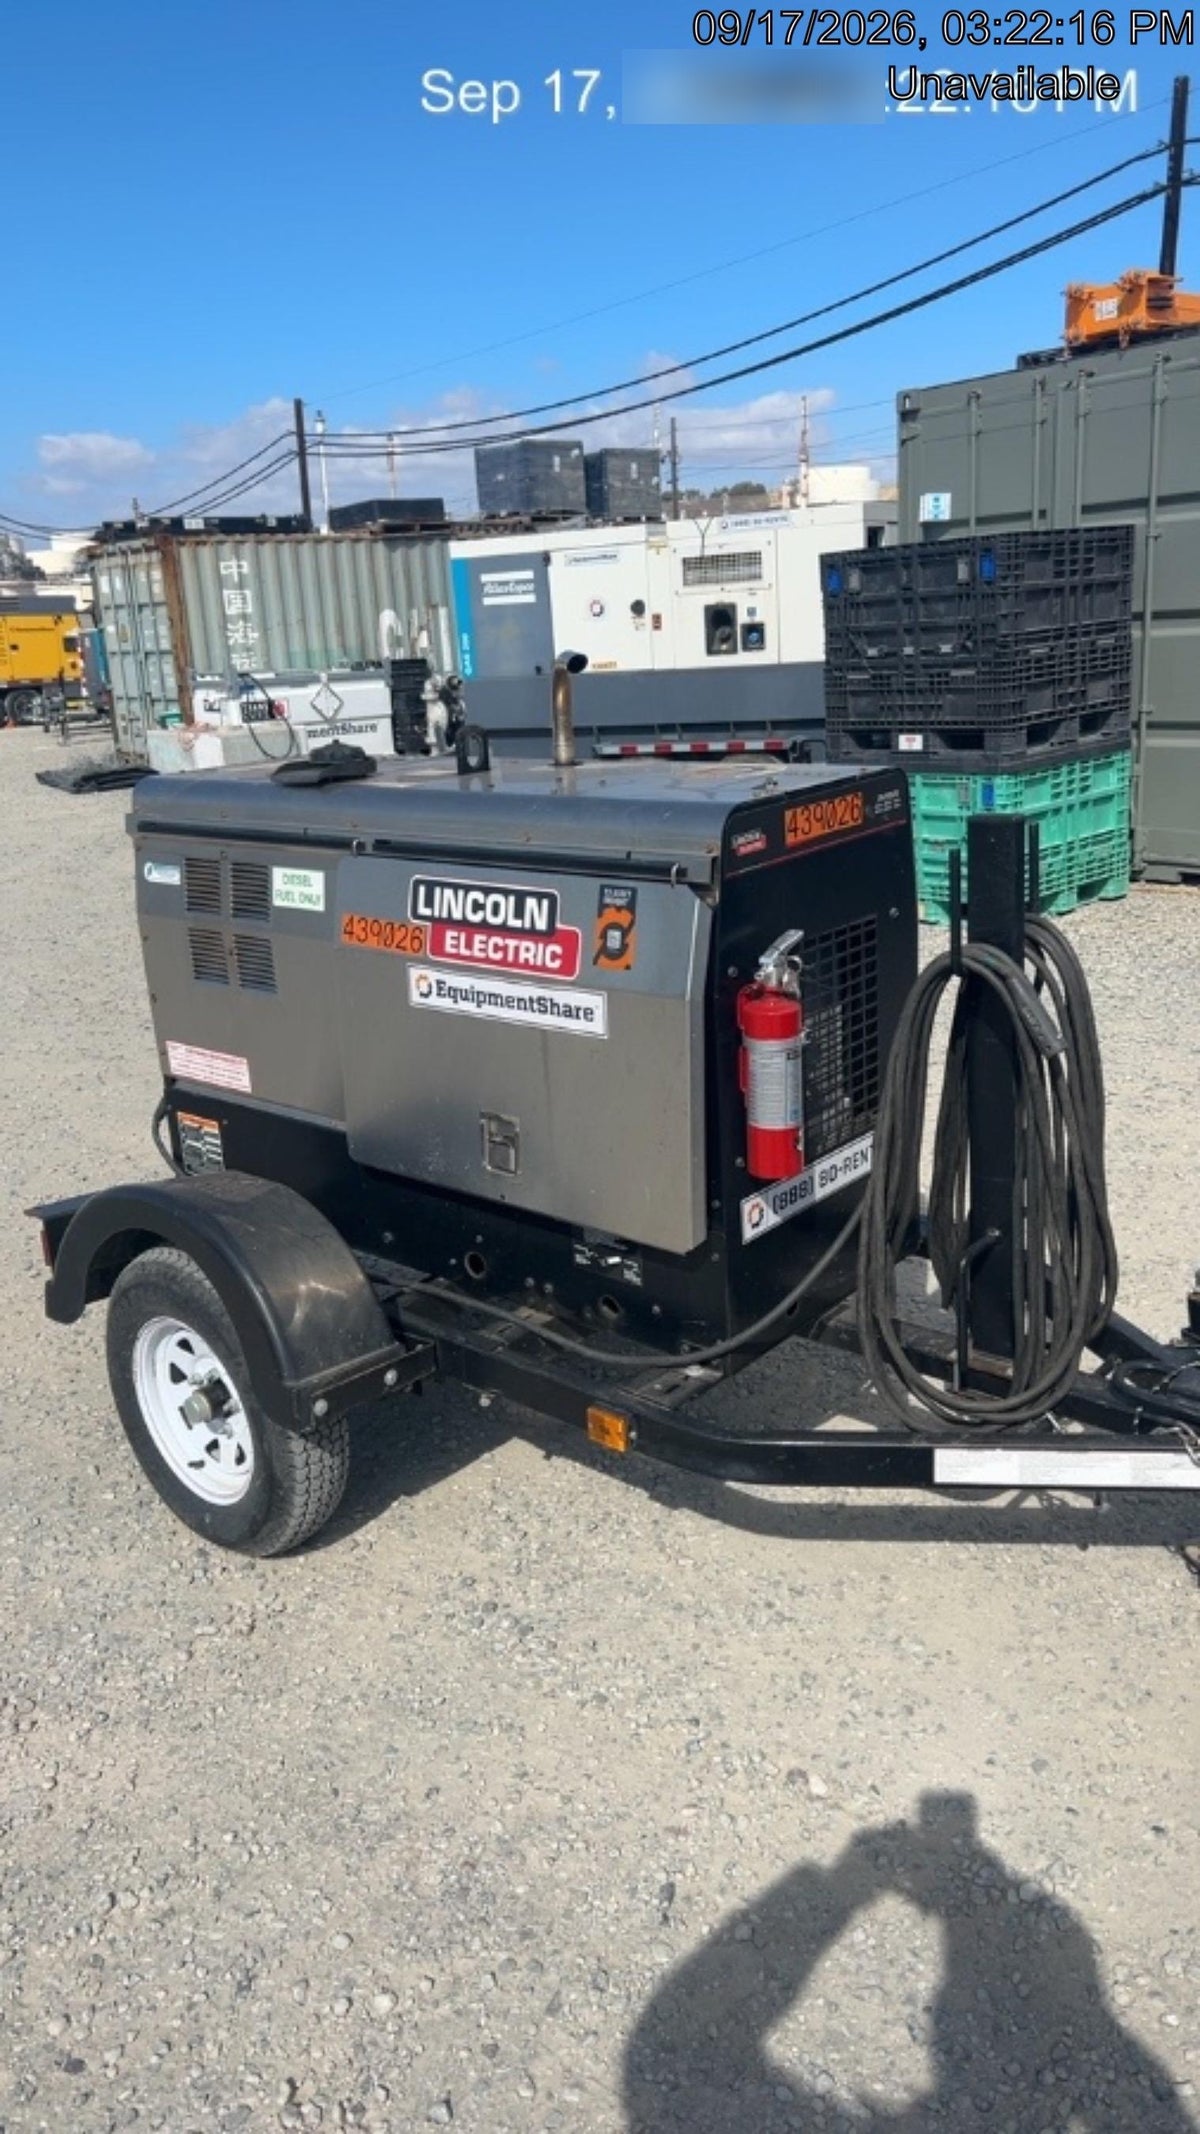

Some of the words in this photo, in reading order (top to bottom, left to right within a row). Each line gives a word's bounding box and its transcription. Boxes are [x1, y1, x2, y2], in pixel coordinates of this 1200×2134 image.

[787, 792, 863, 838] 439026
[416, 884, 550, 932] LINCOLN
[343, 914, 424, 954] 439026
[444, 929, 564, 969] ELECTRIC
[435, 978, 597, 1023] EquipmentShare
